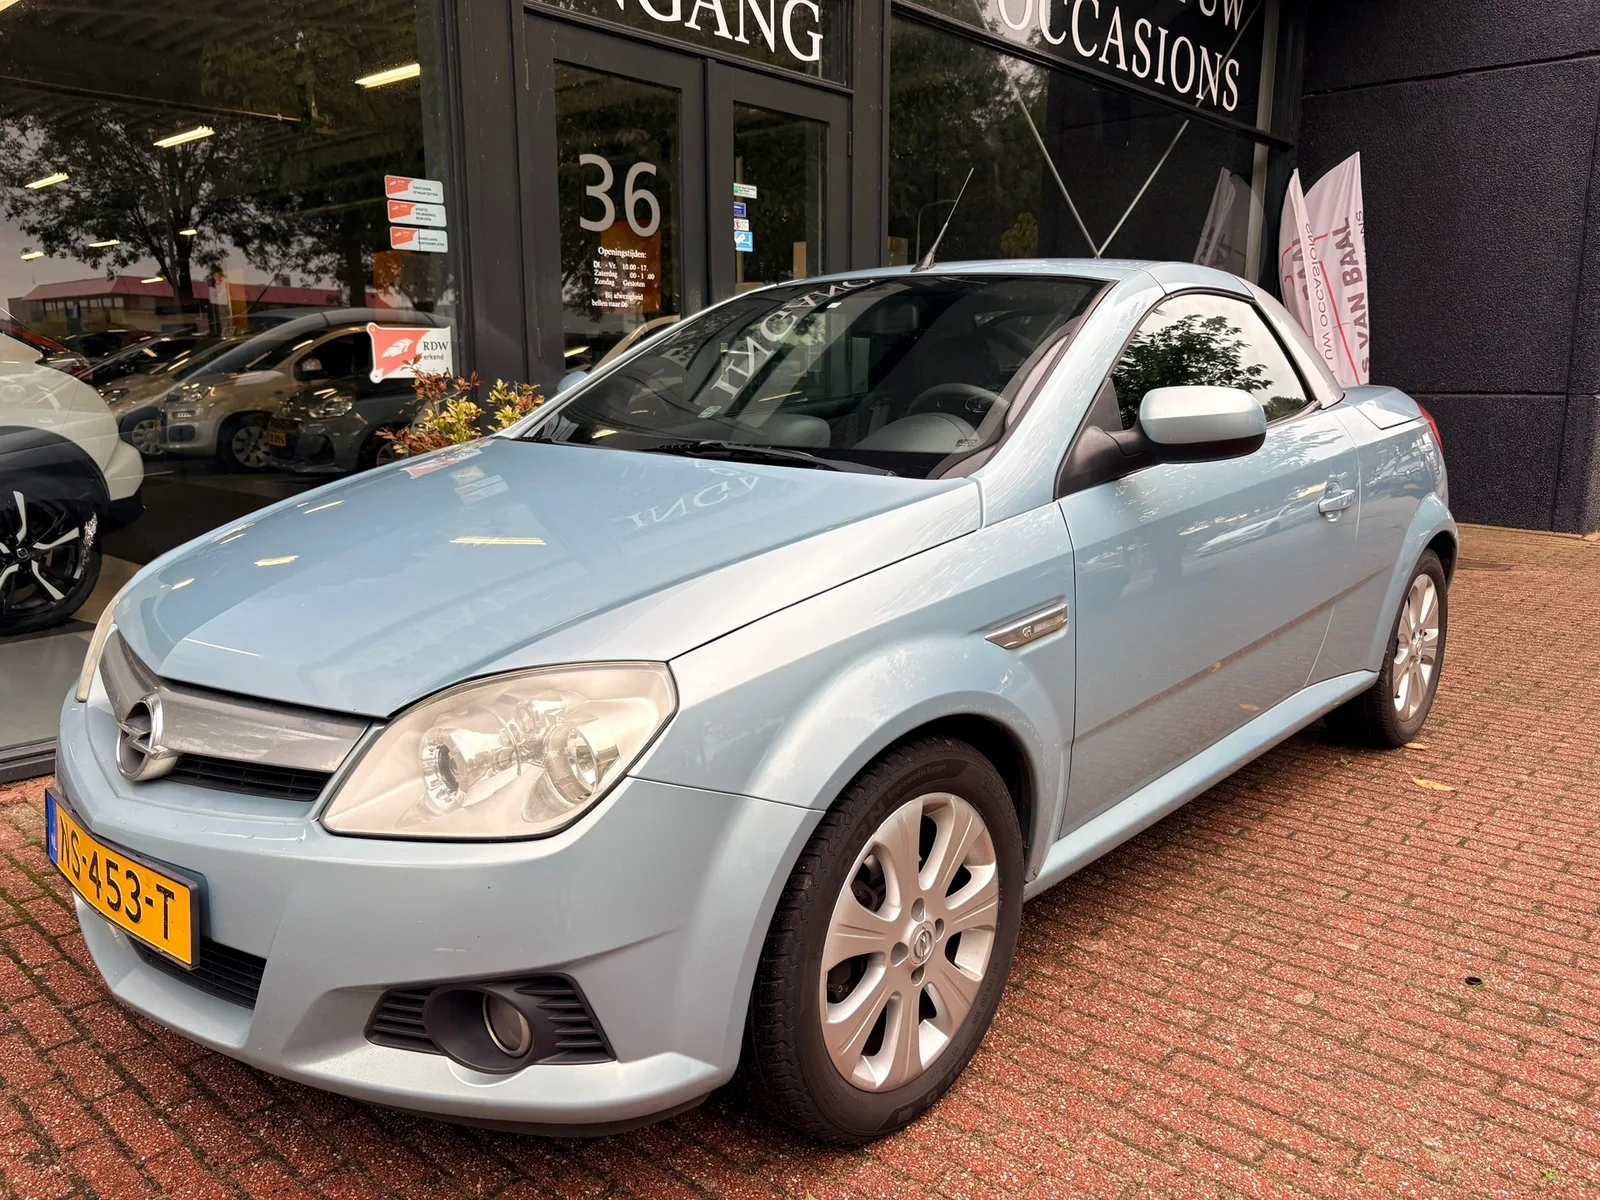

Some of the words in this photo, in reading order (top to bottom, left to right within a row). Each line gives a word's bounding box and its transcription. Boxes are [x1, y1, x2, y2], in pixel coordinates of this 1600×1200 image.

[612, 0, 823, 62] ANG
[578, 153, 661, 237] 36
[597, 246, 647, 259] Openingstijden:
[1332, 216, 1363, 287] BAAL
[594, 269, 618, 279] Zaterdag
[594, 277, 615, 287] Zondag
[591, 298, 608, 307] bellen
[613, 292, 644, 301] afwezigheid
[1347, 292, 1368, 350] VAN
[422, 341, 449, 351] RDW
[59, 815, 175, 940] NS-453-T
